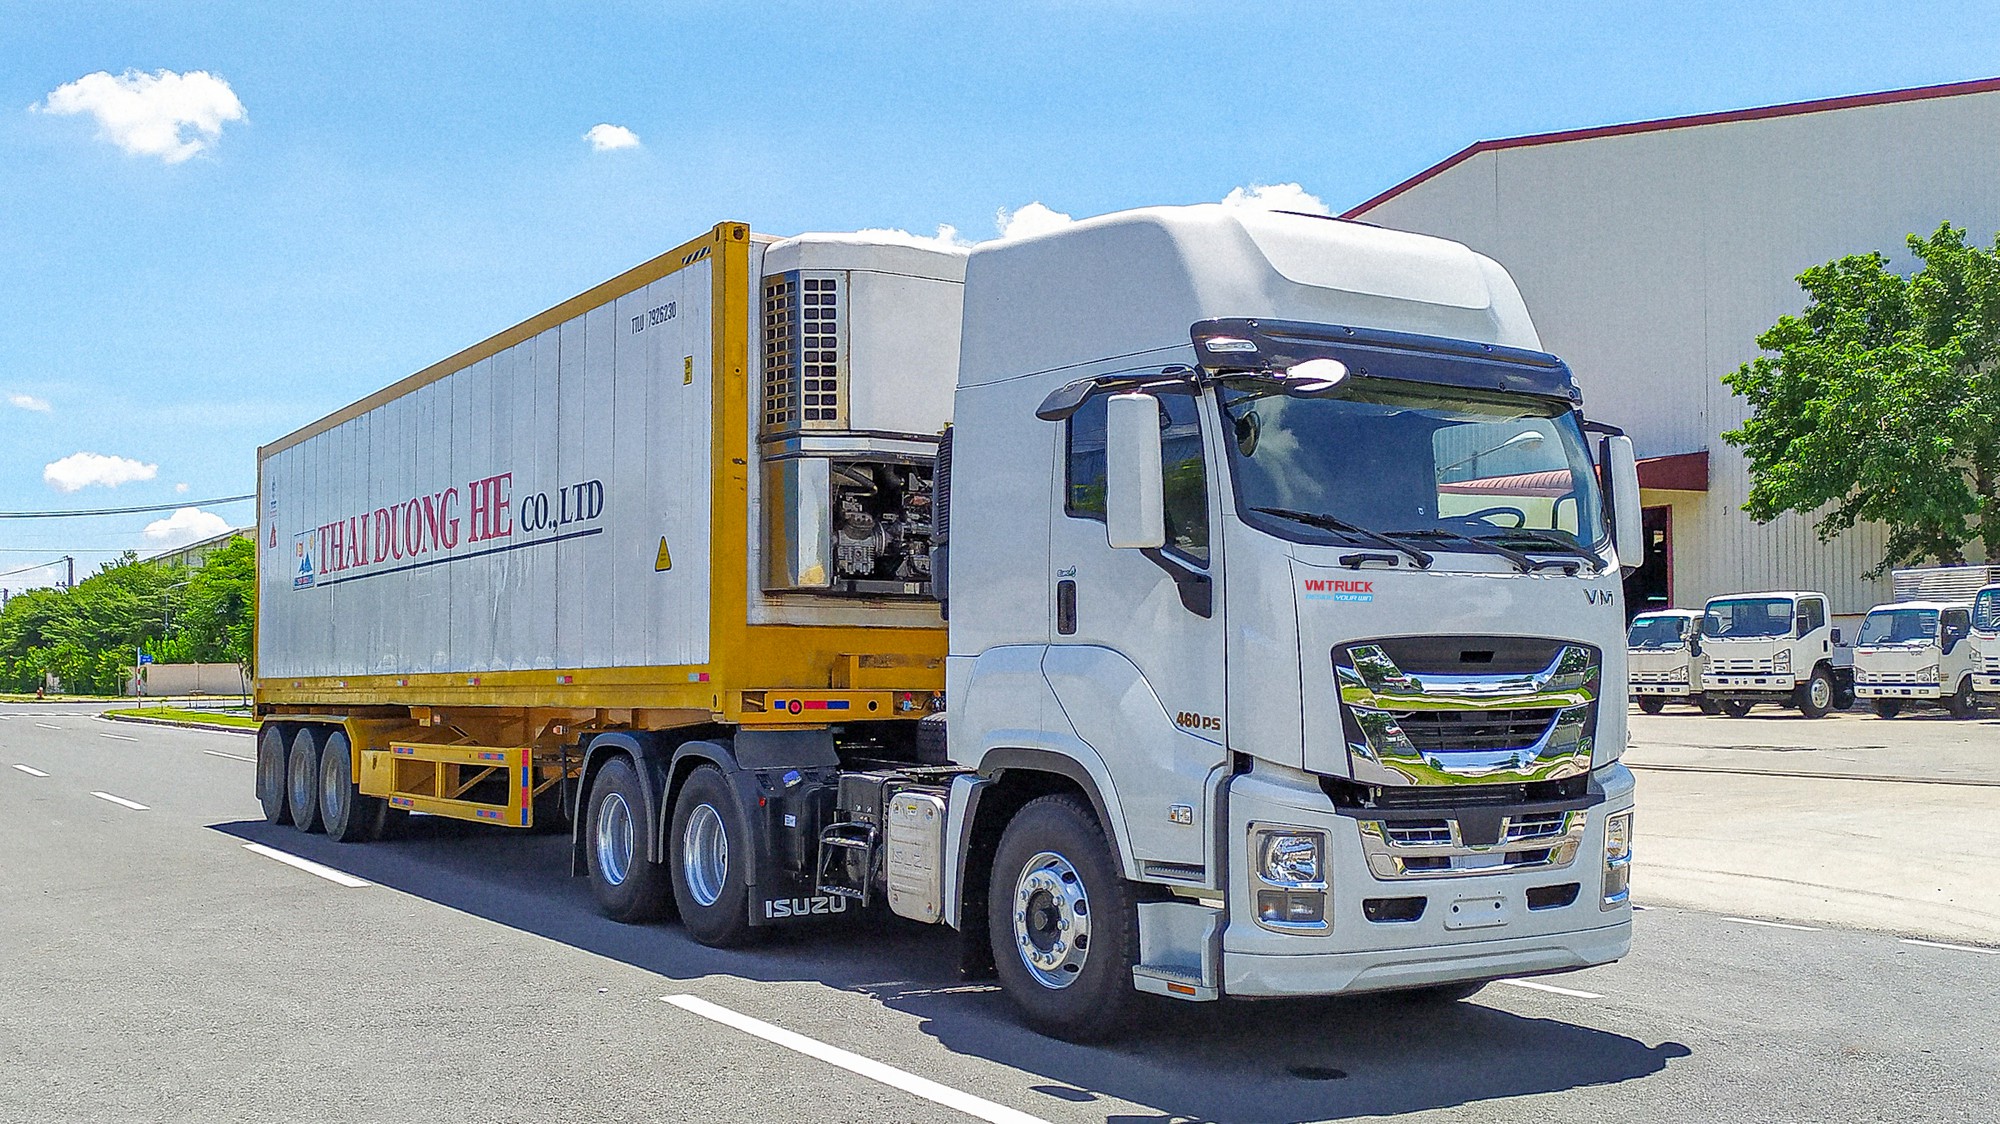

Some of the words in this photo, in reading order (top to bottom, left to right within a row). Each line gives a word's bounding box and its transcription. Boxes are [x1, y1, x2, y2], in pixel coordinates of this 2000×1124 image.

[648, 301, 677, 328] 7926230
[317, 512, 370, 575] THAI
[373, 487, 460, 564] DUONG
[468, 472, 513, 543] HE
[1582, 588, 1614, 607] VM
[1176, 711, 1201, 729] 460
[1202, 717, 1221, 731] PS
[765, 895, 847, 919] ISUZU
